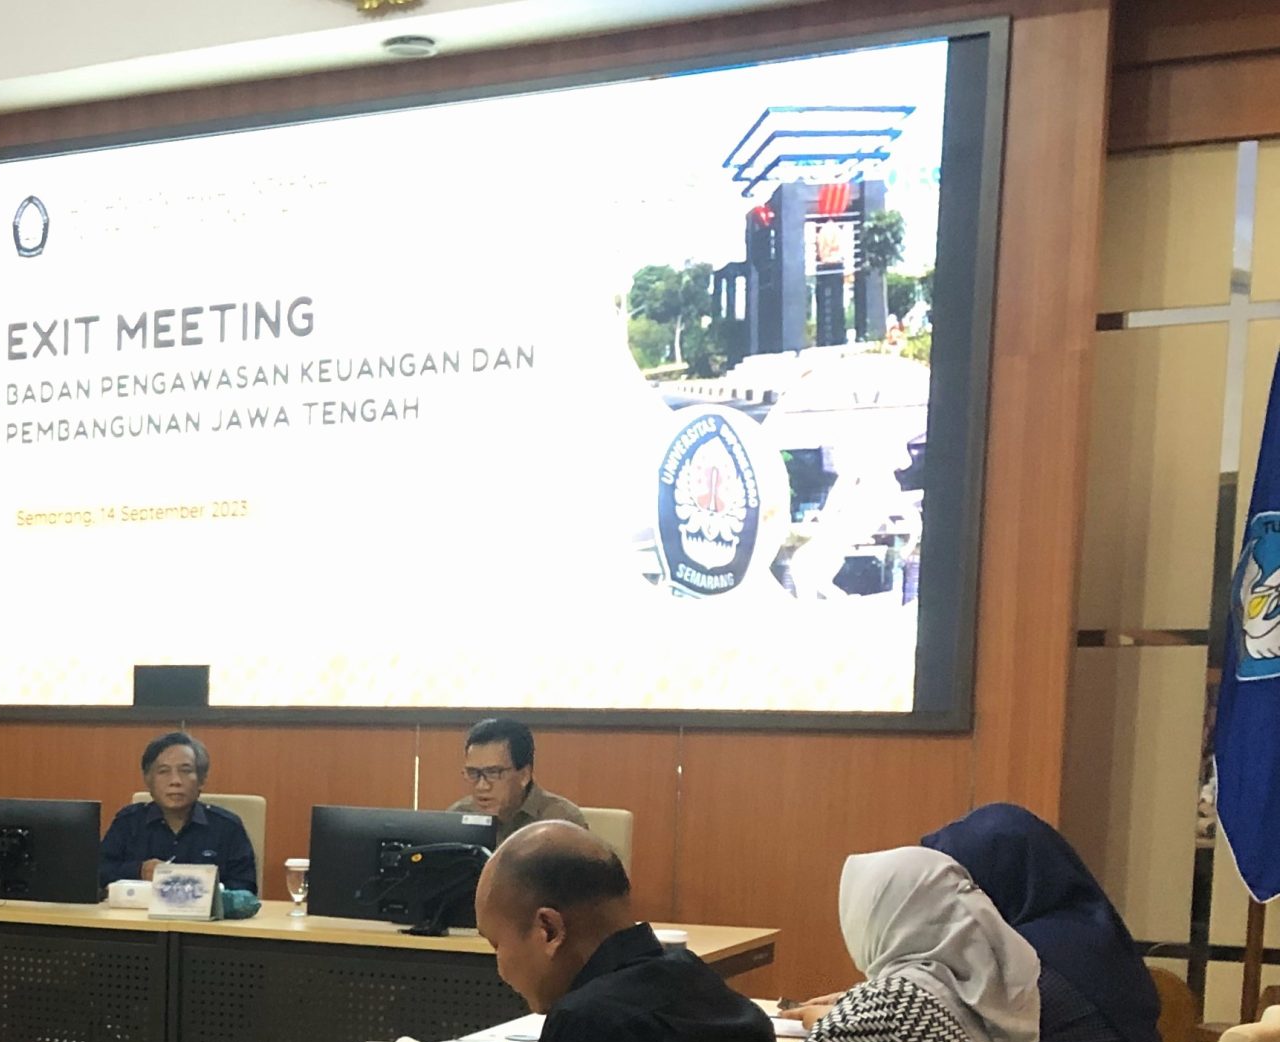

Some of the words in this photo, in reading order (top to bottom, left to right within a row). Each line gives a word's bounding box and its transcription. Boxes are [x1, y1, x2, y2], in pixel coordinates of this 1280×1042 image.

[7, 315, 100, 361] EXIT
[116, 295, 314, 351] MEETING
[6, 379, 91, 406] BADAN
[100, 364, 289, 398] PENGAWASAN
[300, 350, 460, 384] KEUANGAN
[472, 345, 534, 373] DAN
[6, 412, 200, 444] PEMBANGUNAN
[211, 406, 290, 433] JAWA
[302, 396, 419, 426] TENGAH
[661, 416, 717, 485] UNIVERSITAS
[121, 504, 205, 522] September
[211, 500, 248, 518] 2023
[676, 563, 735, 589] SEMARANG
